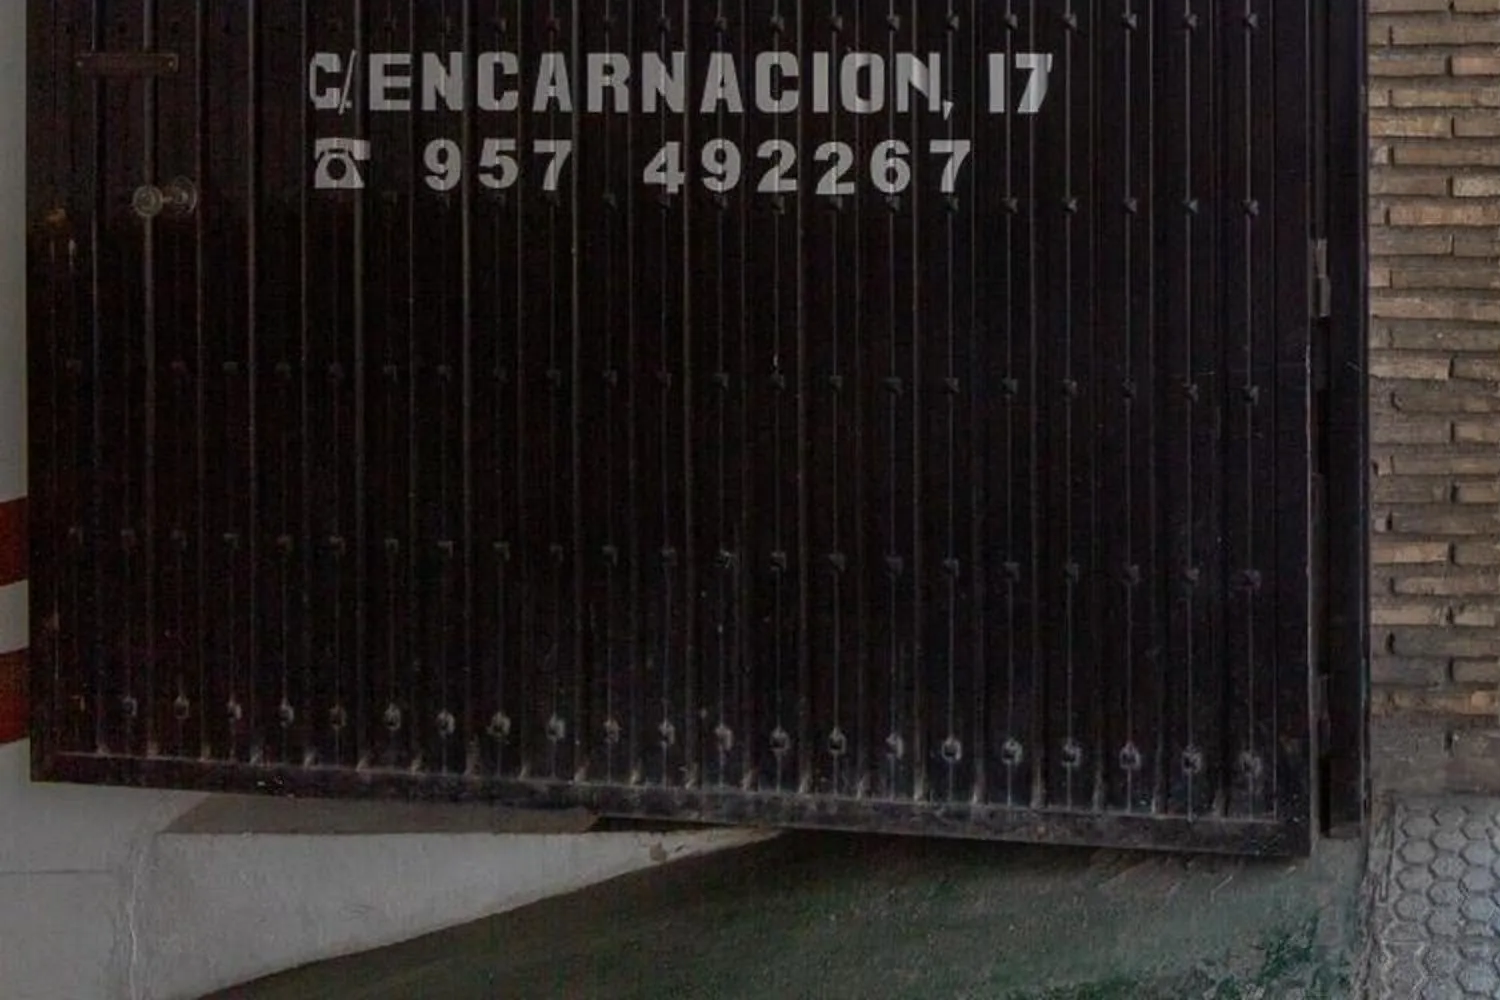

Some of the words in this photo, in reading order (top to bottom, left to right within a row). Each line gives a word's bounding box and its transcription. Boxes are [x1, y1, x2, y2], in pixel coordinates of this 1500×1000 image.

[988, 53, 1053, 113] 17
[423, 138, 572, 191] 957
[642, 138, 971, 195] 492267
